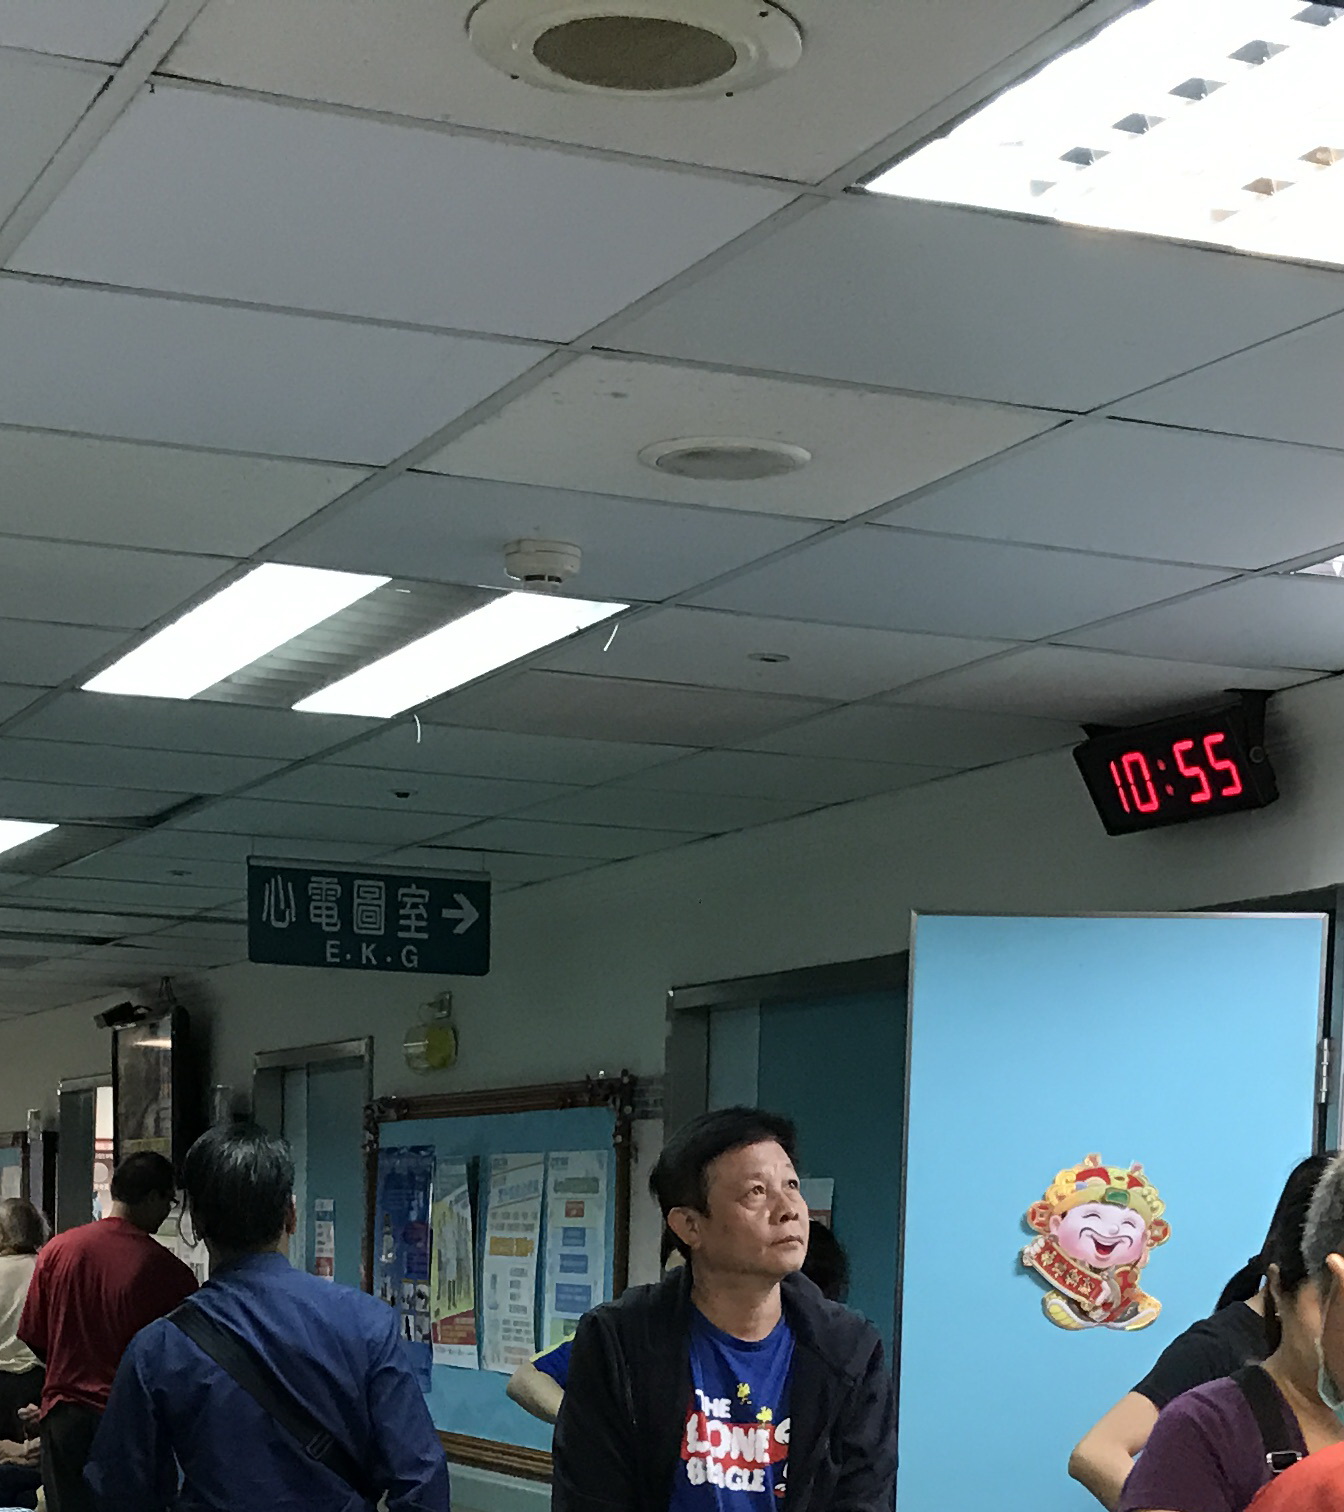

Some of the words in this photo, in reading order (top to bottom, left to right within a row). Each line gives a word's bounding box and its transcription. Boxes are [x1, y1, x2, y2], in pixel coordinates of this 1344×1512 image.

[1110, 732, 1244, 815] 10:55
[262, 875, 431, 940] 心電圖室
[686, 1413, 771, 1463] LONE
